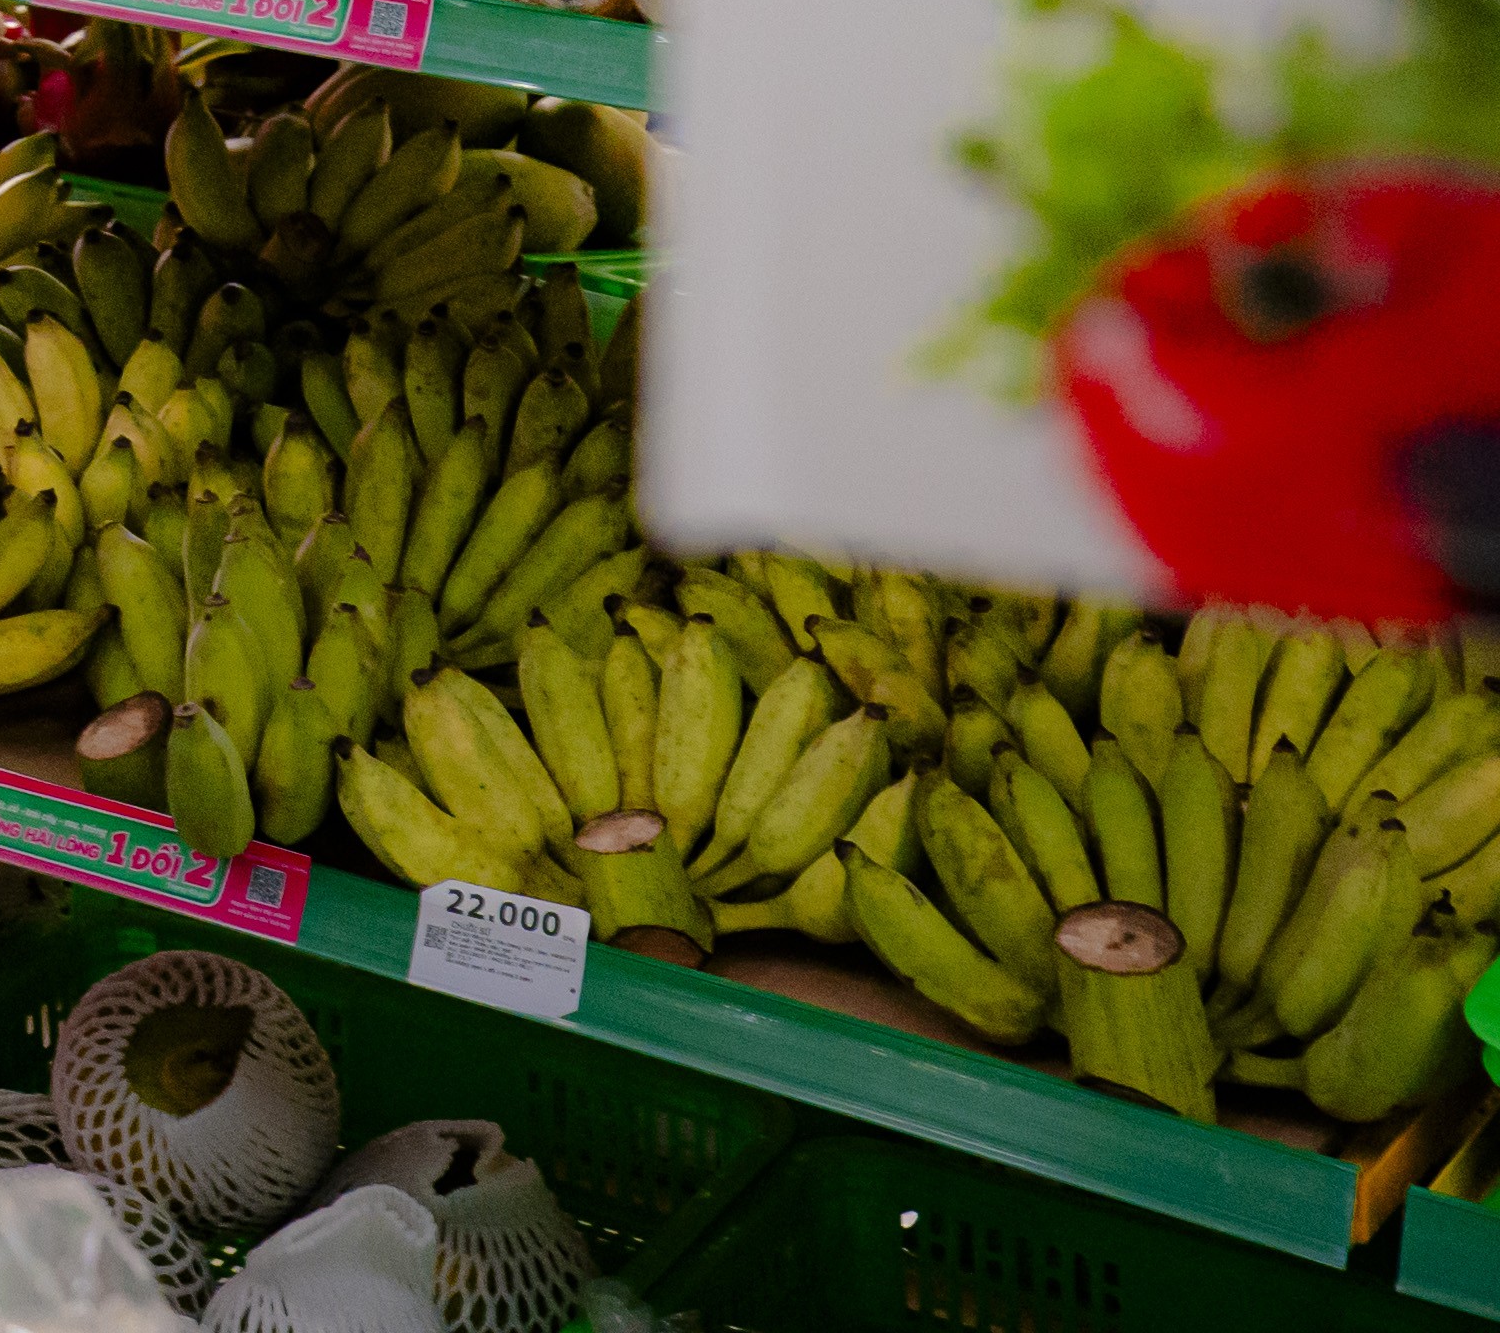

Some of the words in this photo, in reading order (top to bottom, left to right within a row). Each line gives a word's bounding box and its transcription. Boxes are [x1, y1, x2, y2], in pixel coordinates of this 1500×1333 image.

[105, 830, 130, 868] 1
[183, 852, 220, 891] 2
[446, 888, 561, 937] 22.000
